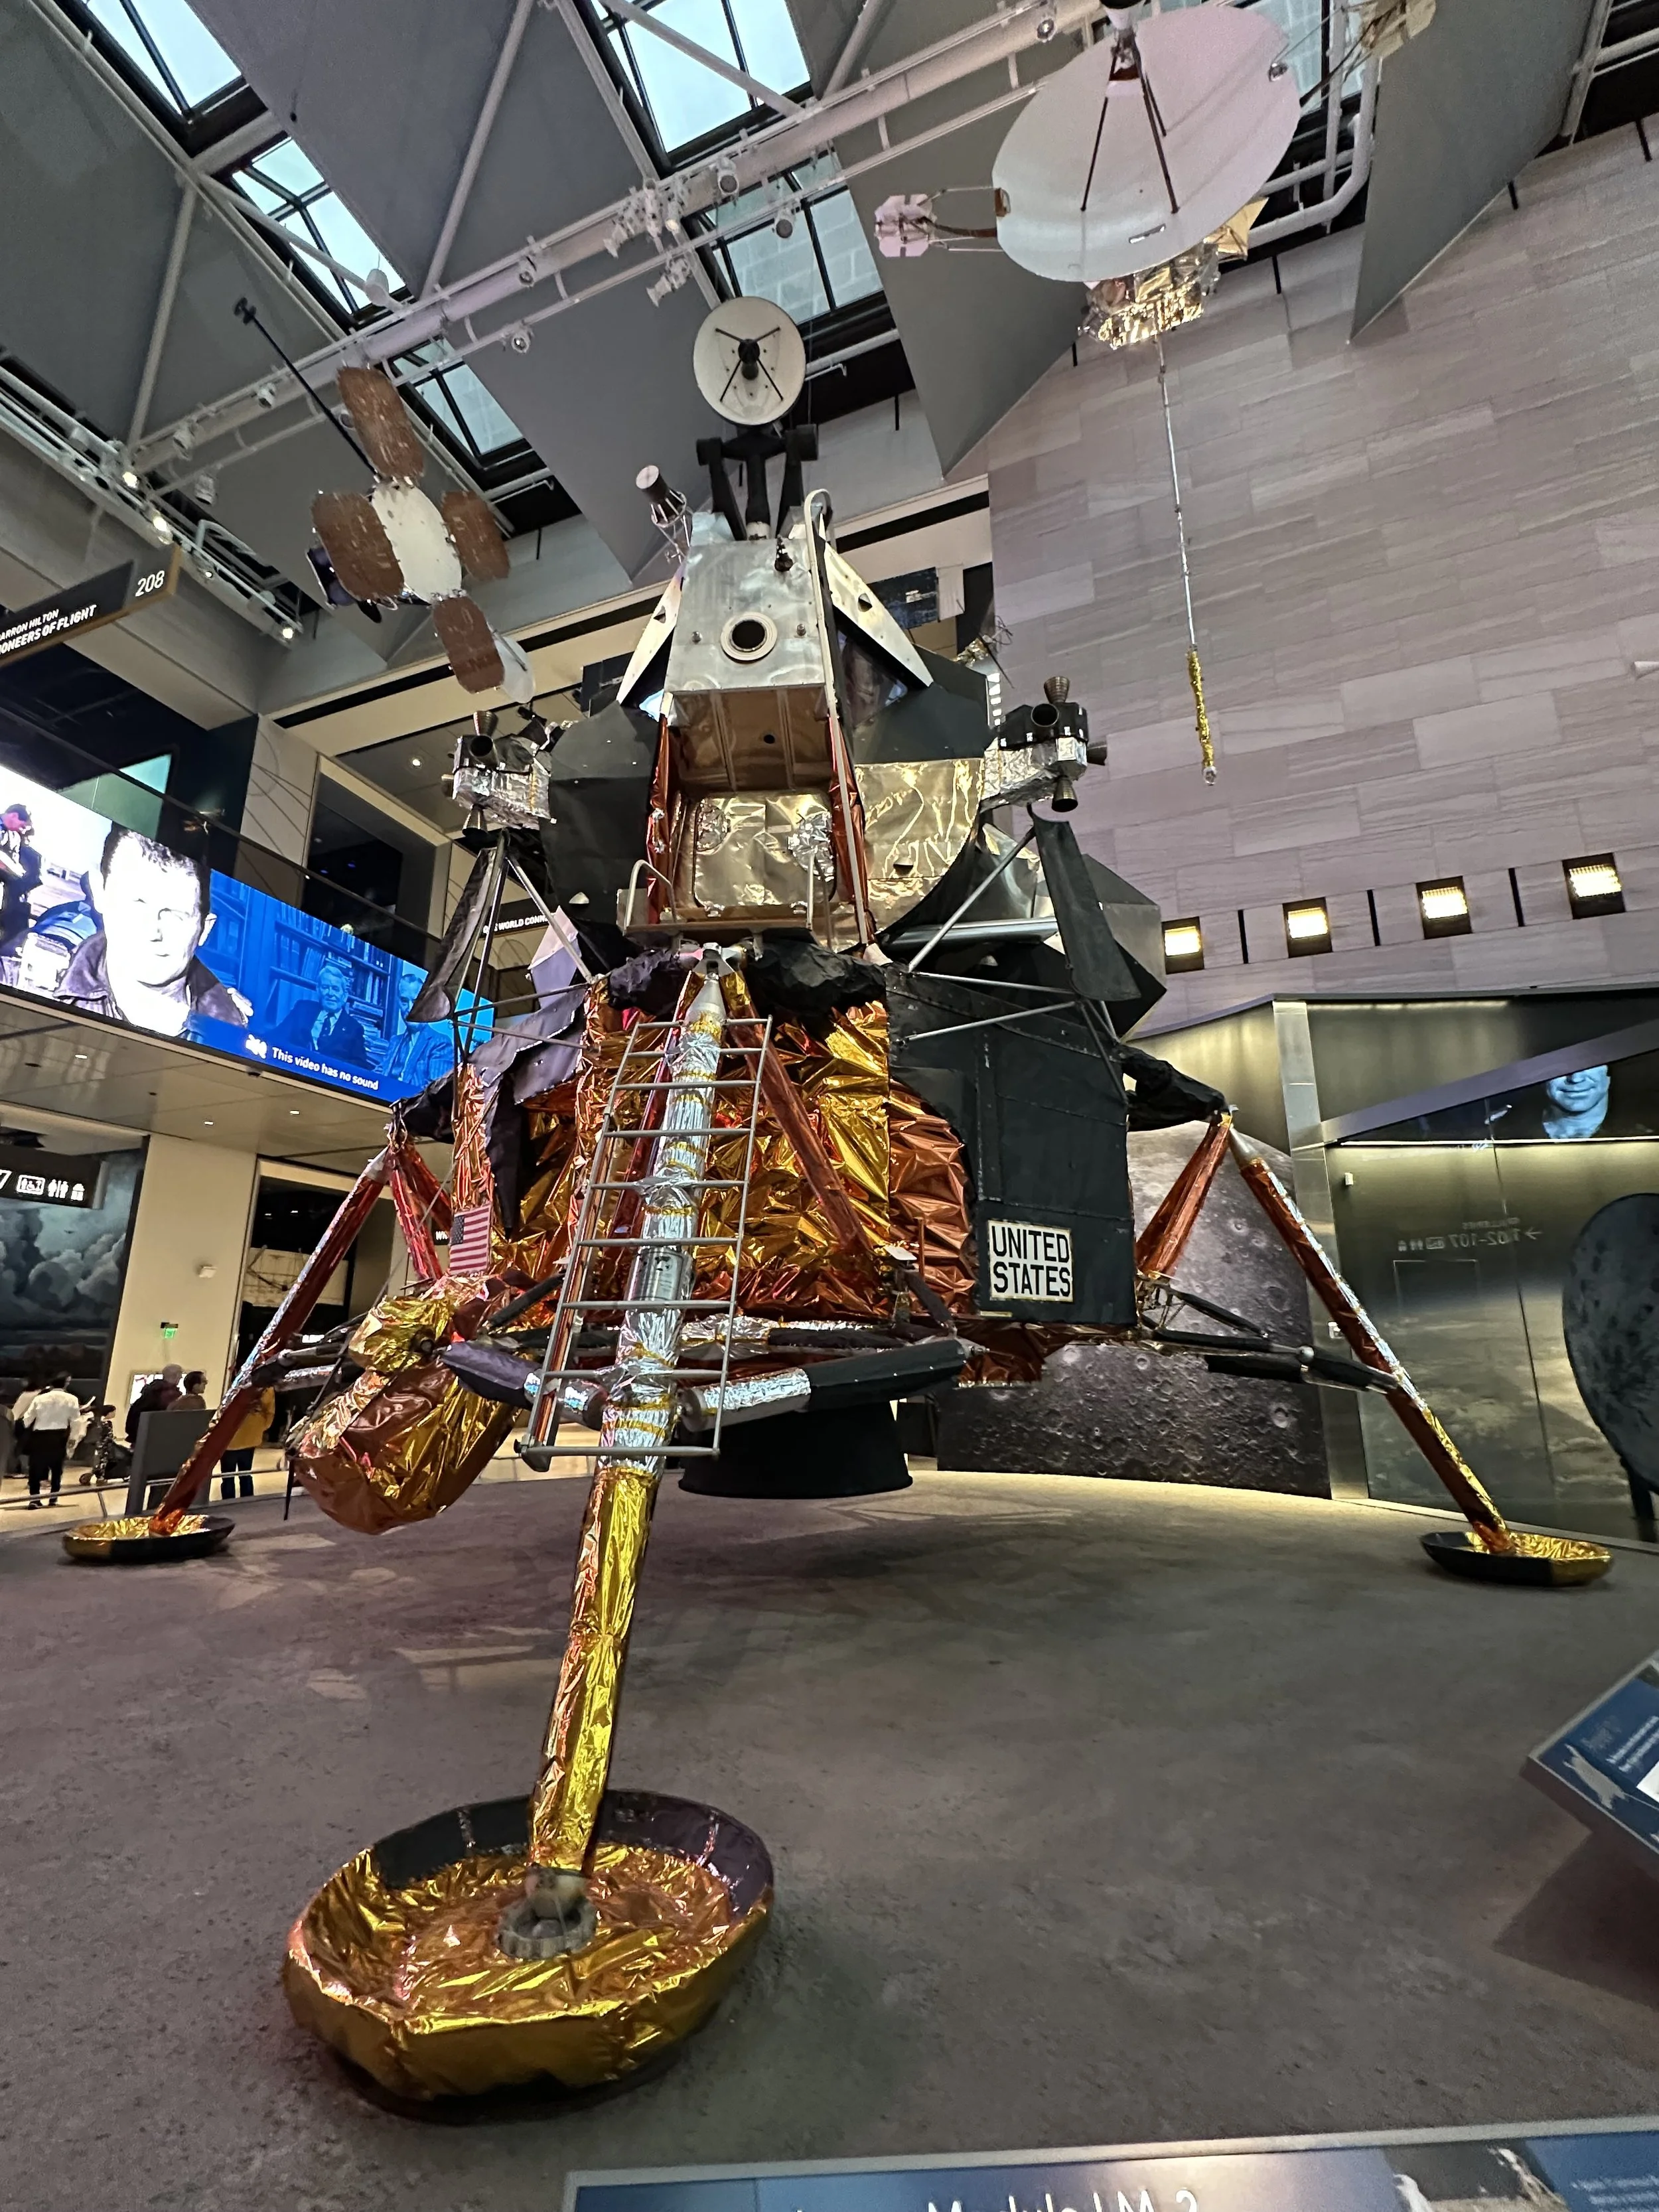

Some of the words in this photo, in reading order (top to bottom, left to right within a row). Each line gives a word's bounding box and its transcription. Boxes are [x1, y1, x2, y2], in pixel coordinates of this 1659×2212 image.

[135, 570, 165, 597] 208
[29, 609, 60, 630] HILTON
[41, 621, 57, 636] OF
[56, 604, 98, 631] FLIGHT
[498, 919, 524, 930] WORLD
[272, 1047, 293, 1064] This
[295, 1057, 321, 1072] video
[321, 1063, 338, 1078] has
[339, 1070, 351, 1082] no
[352, 1074, 379, 1090] sound
[991, 1226, 1070, 1263] UNITED
[993, 1261, 1071, 1297] STATES
